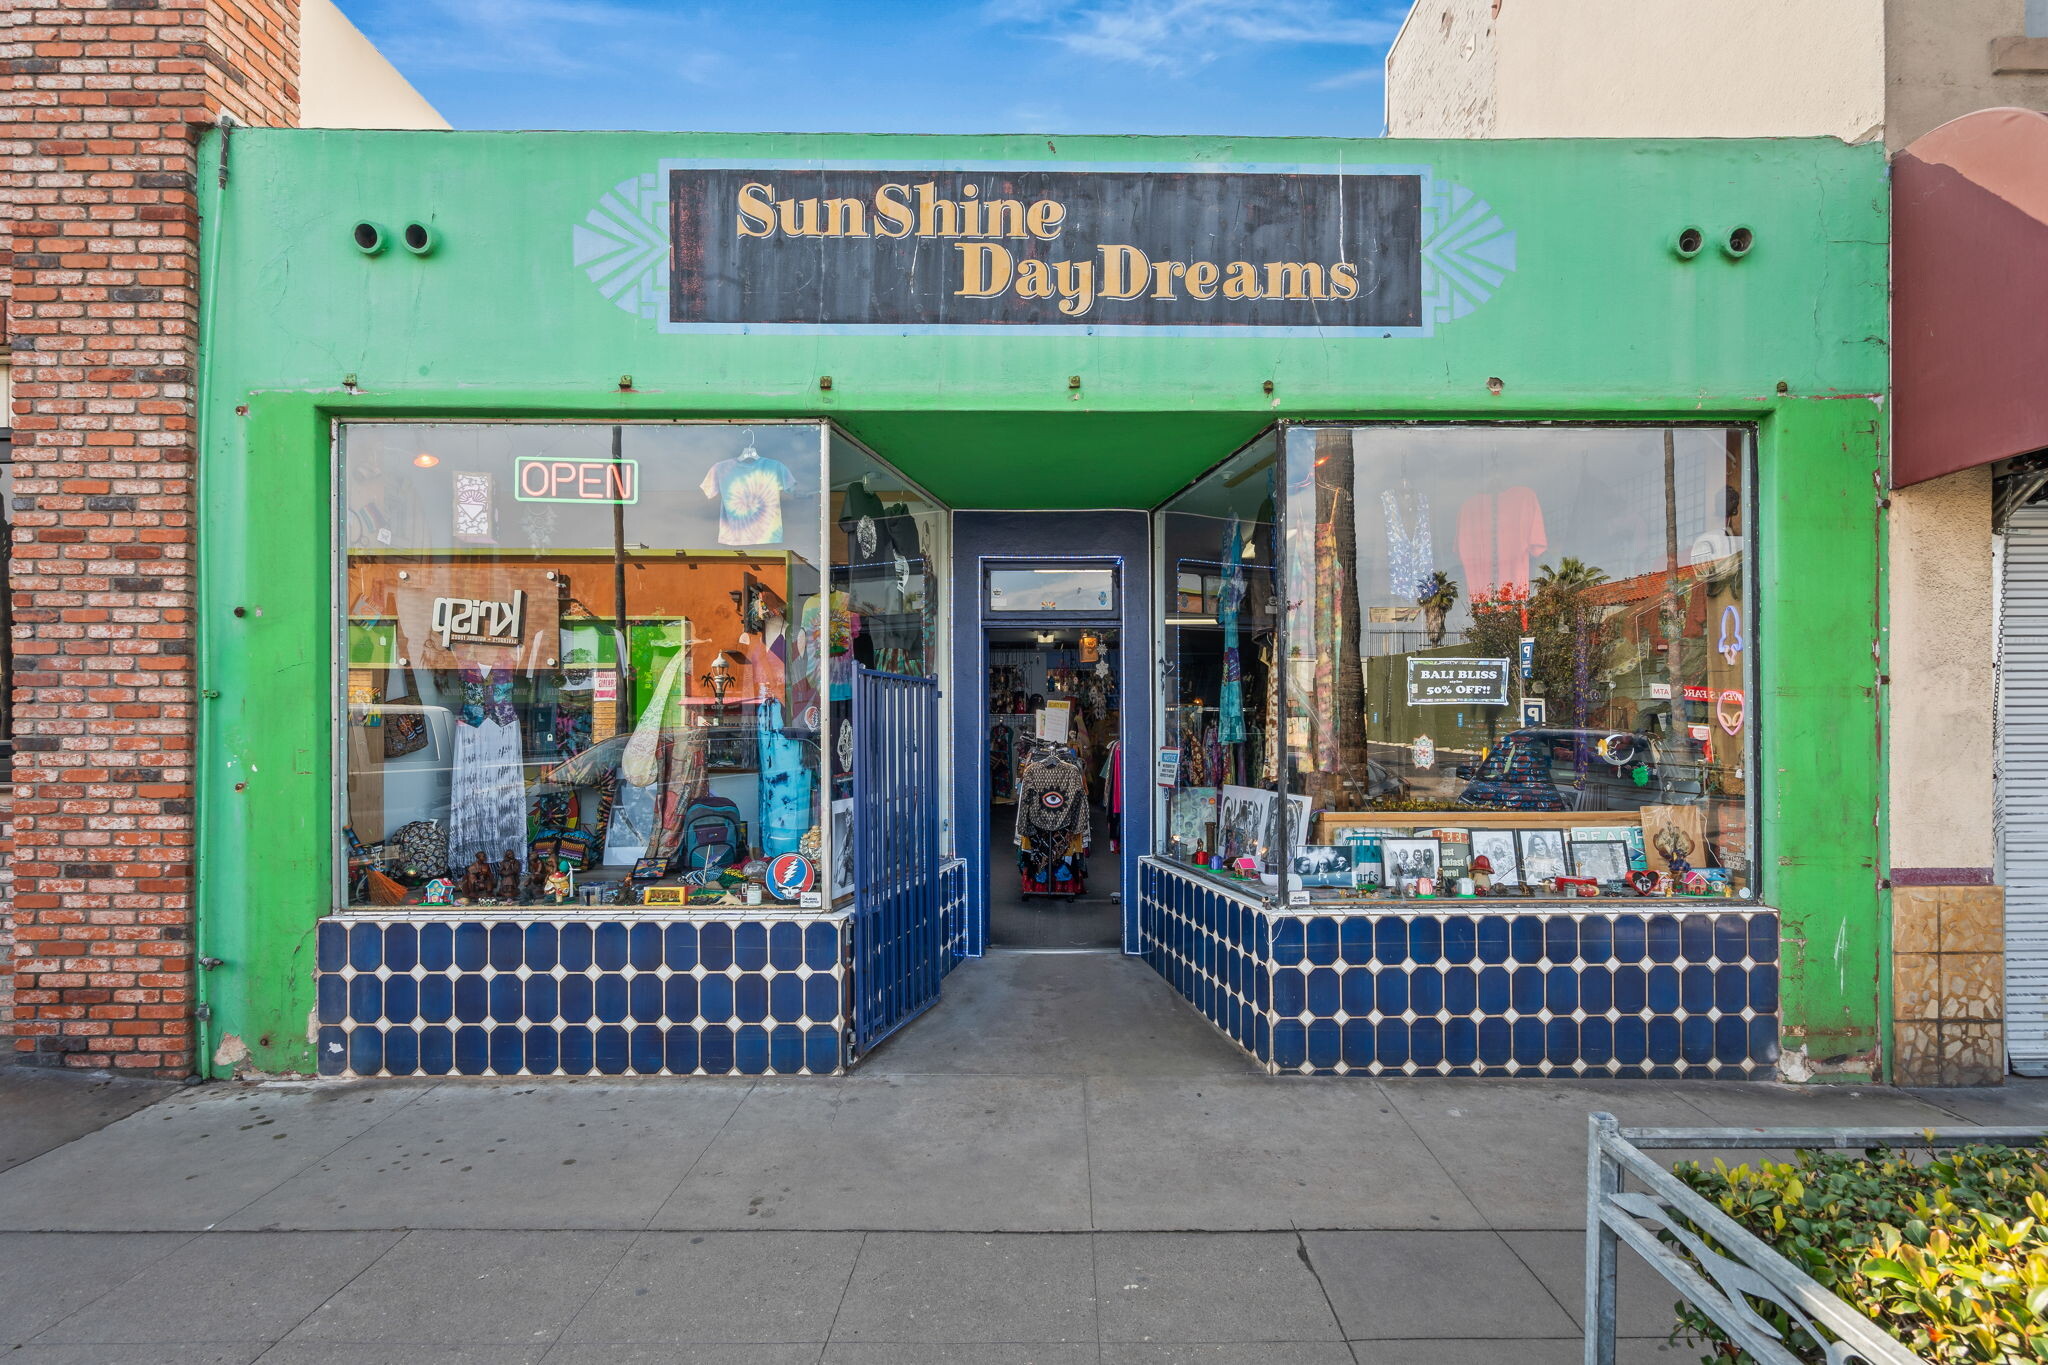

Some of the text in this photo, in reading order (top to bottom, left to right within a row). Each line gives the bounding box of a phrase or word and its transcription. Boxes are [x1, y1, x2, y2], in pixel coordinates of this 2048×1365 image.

[736, 181, 1067, 243] SunShine
[954, 242, 1360, 317] DayDreams
[522, 462, 632, 499] OPEN
[1421, 670, 1498, 680] BALI BLISS
[1426, 685, 1491, 695] 50% OFF!!
[1356, 870, 1379, 882] urfs
